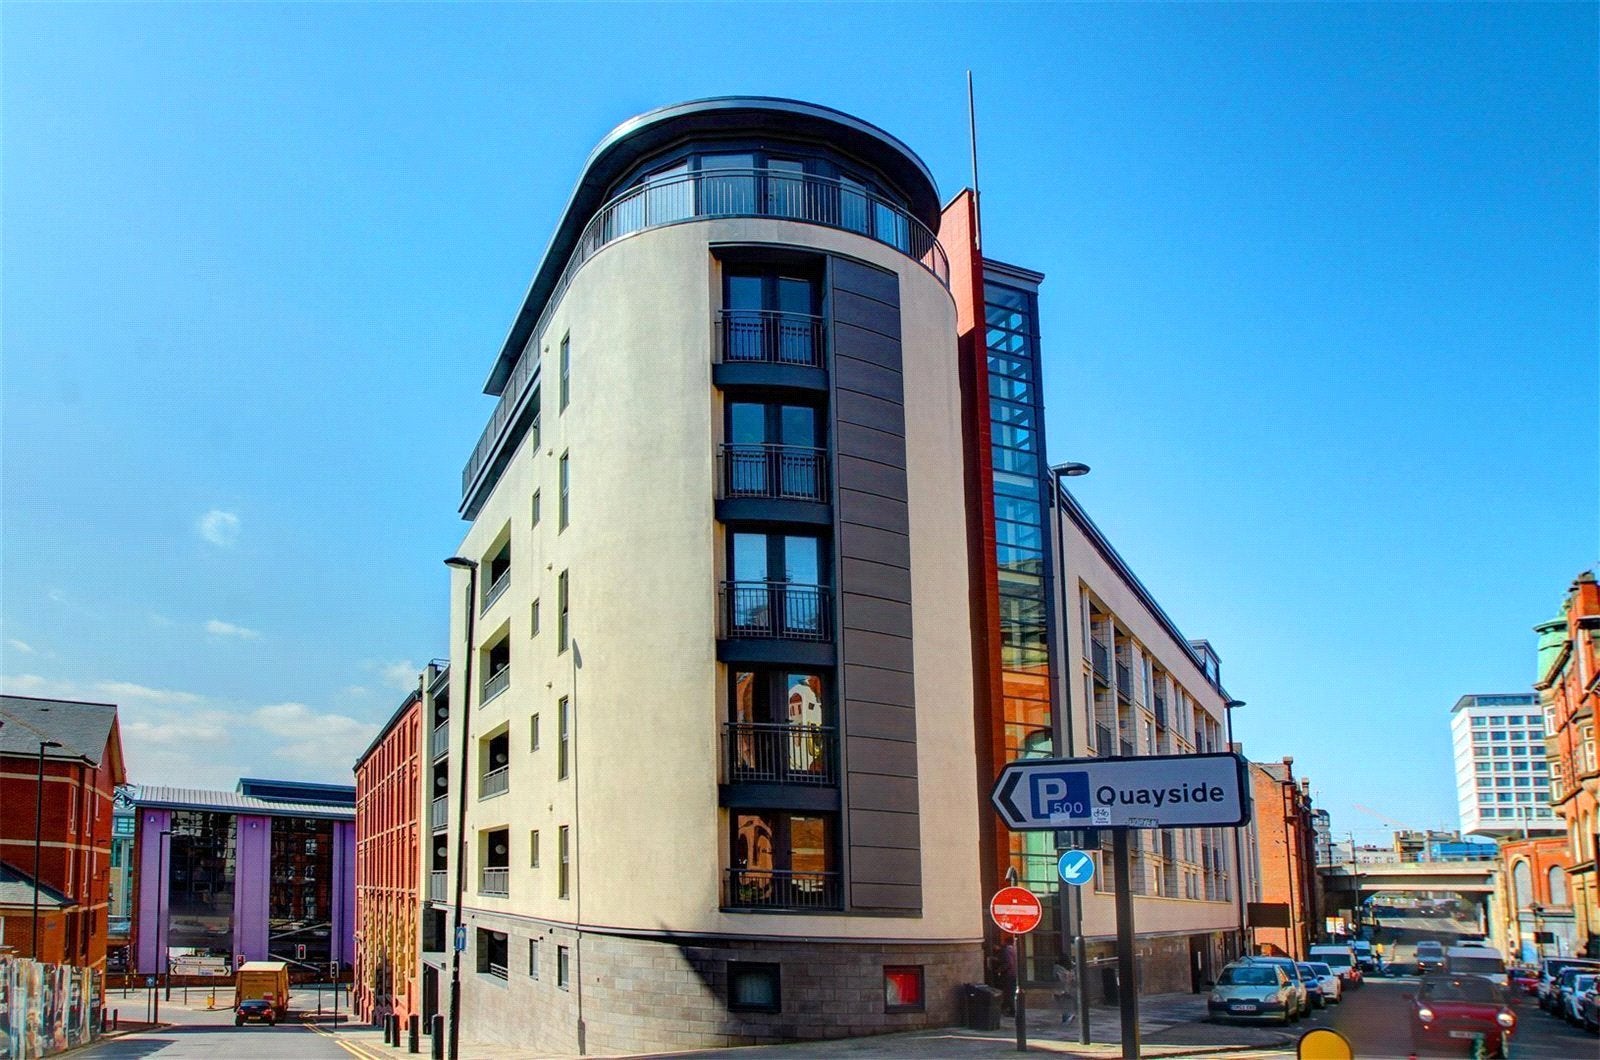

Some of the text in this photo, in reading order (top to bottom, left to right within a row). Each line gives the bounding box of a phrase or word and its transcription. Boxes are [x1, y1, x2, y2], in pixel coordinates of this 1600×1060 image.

[1037, 777, 1067, 814] P
[1053, 802, 1083, 814] 500
[1096, 782, 1225, 808] Quayside
